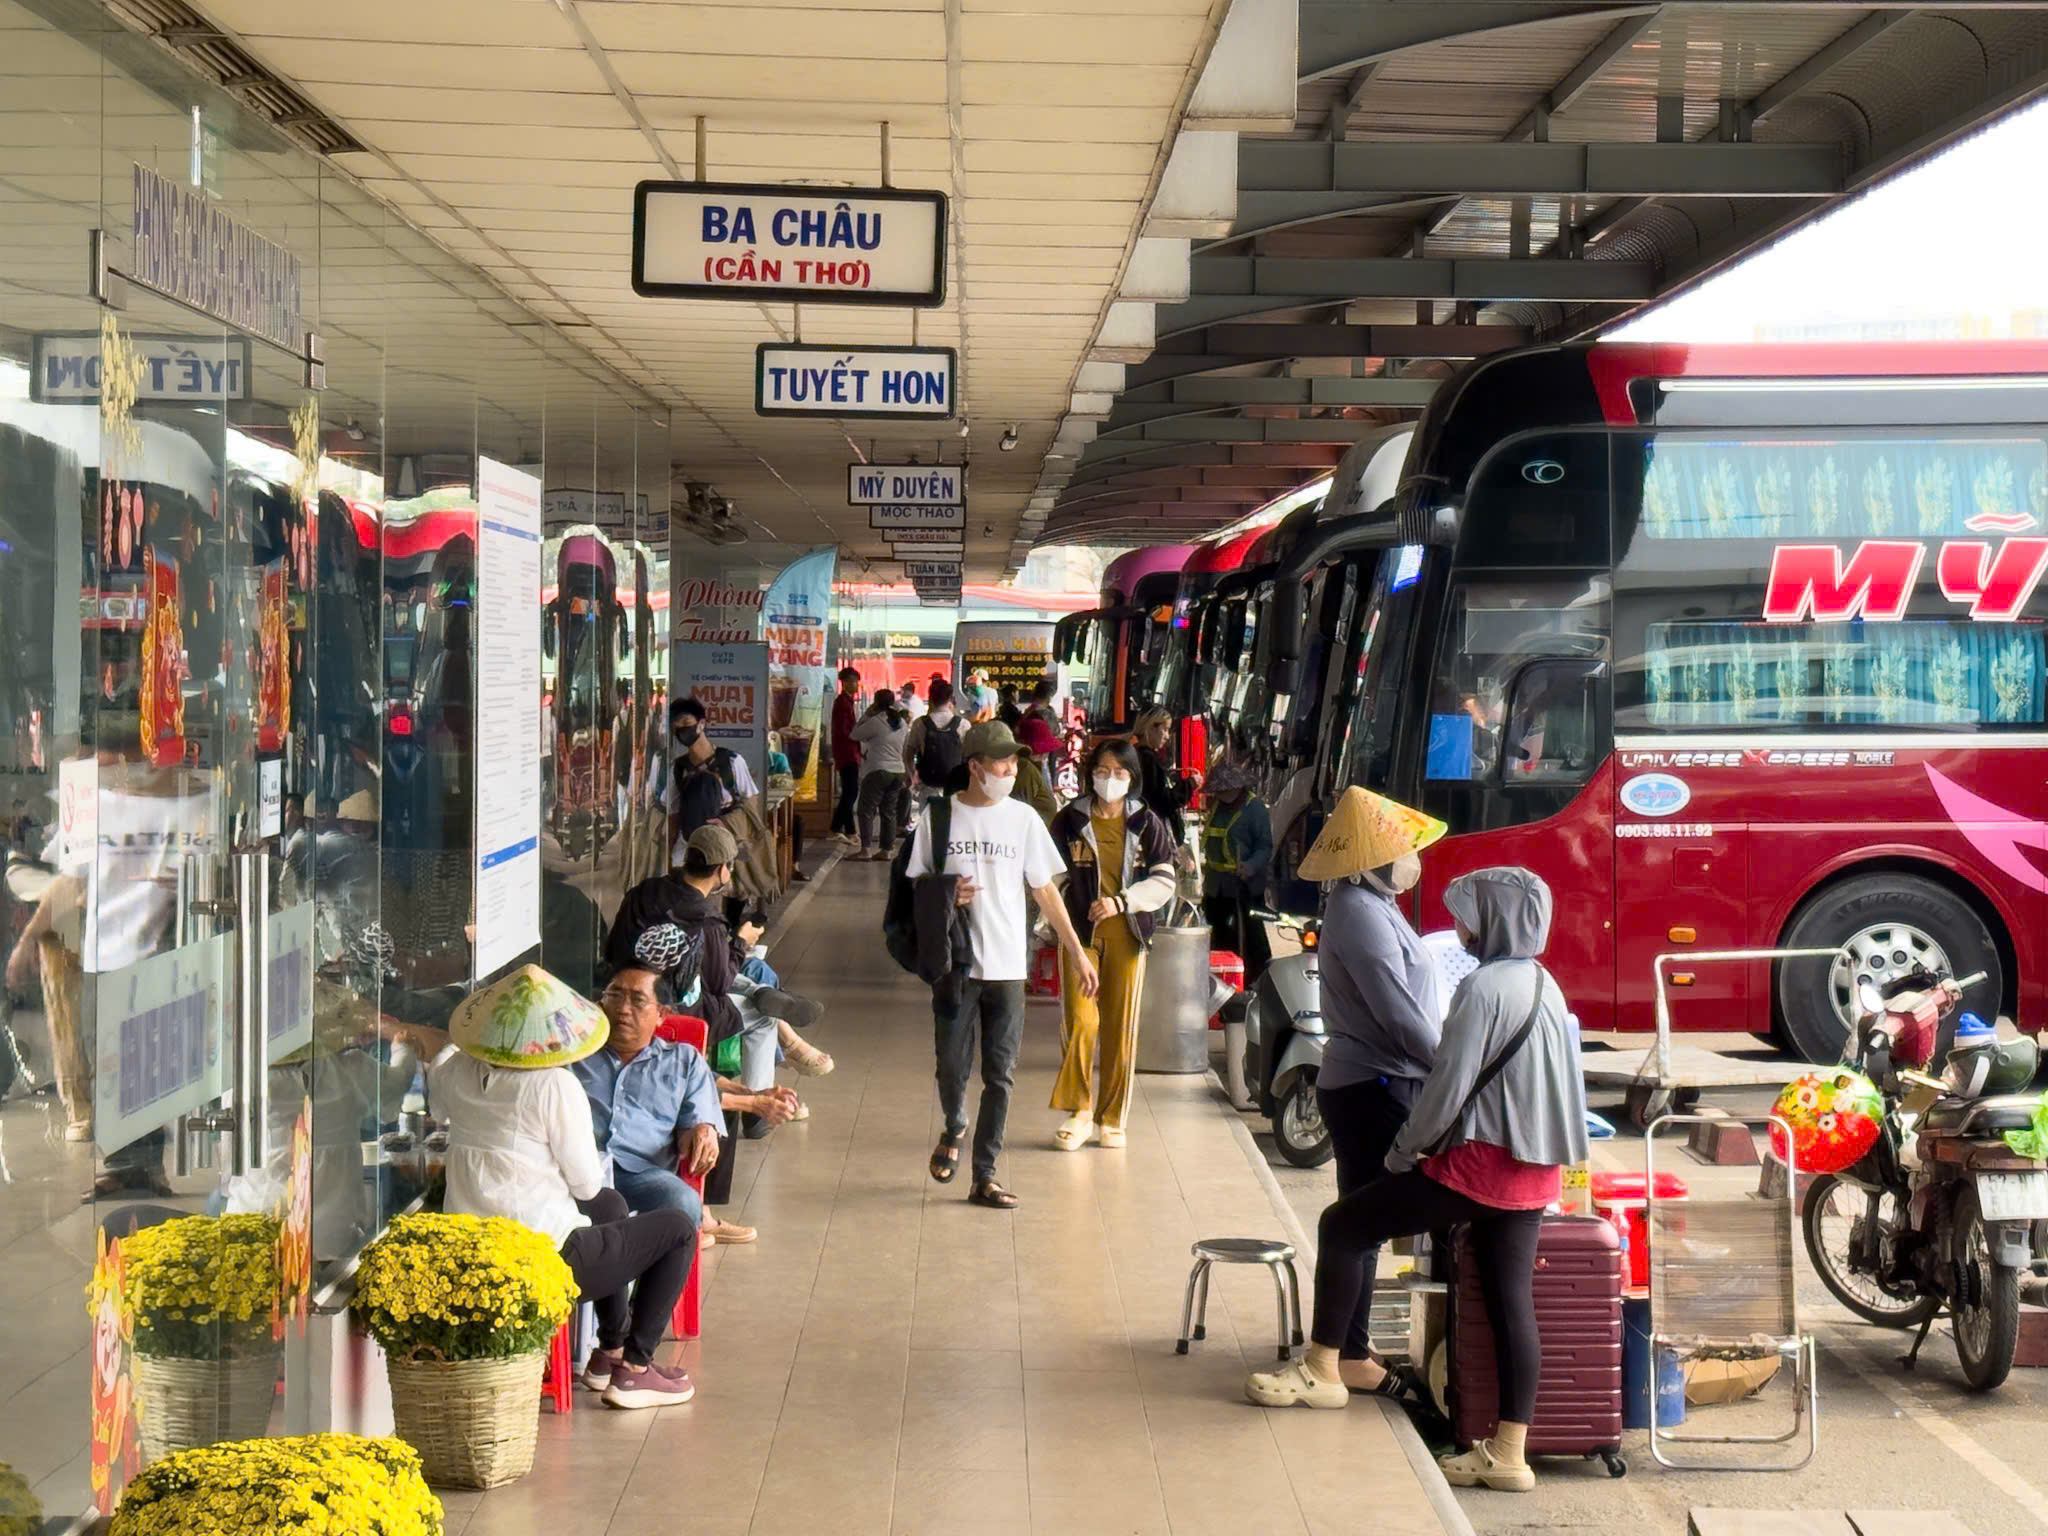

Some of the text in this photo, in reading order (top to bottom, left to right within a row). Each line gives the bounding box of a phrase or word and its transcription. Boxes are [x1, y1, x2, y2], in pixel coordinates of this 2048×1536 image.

[702, 202, 881, 250] BA CHÂU
[704, 250, 870, 288] (CẦN THƠ)
[769, 355, 945, 404] TUYẾT HON
[858, 471, 954, 499] MỸ DUYÊN
[1762, 511, 2048, 622] MỸ
[679, 578, 767, 612] Phòng
[765, 627, 812, 647] MUA
[691, 685, 741, 703] MUA
[704, 702, 755, 727] ẶNG
[947, 840, 1017, 860] SSENTIALS
